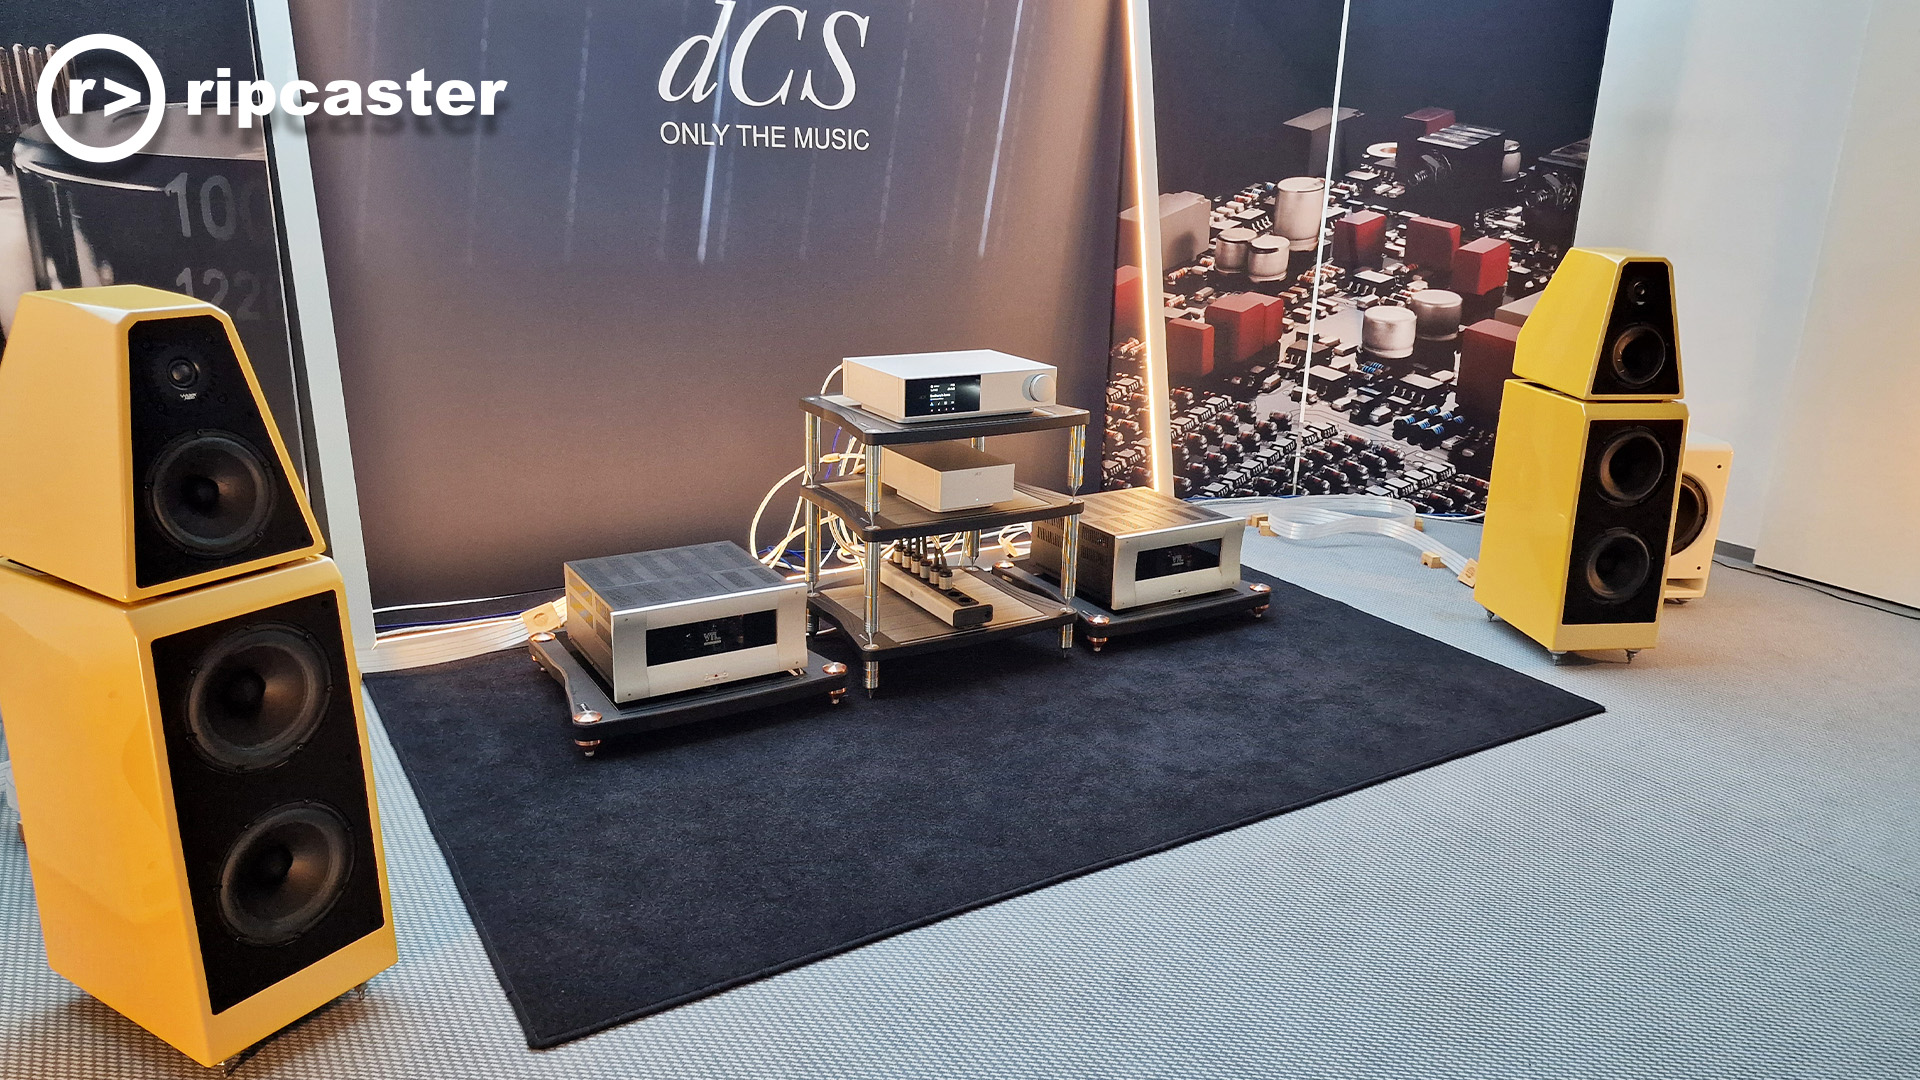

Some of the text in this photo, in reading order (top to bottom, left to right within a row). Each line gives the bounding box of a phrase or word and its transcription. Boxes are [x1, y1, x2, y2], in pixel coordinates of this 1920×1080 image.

[658, 0, 870, 110] dCS
[660, 121, 870, 151] ONLY THE MUSIC
